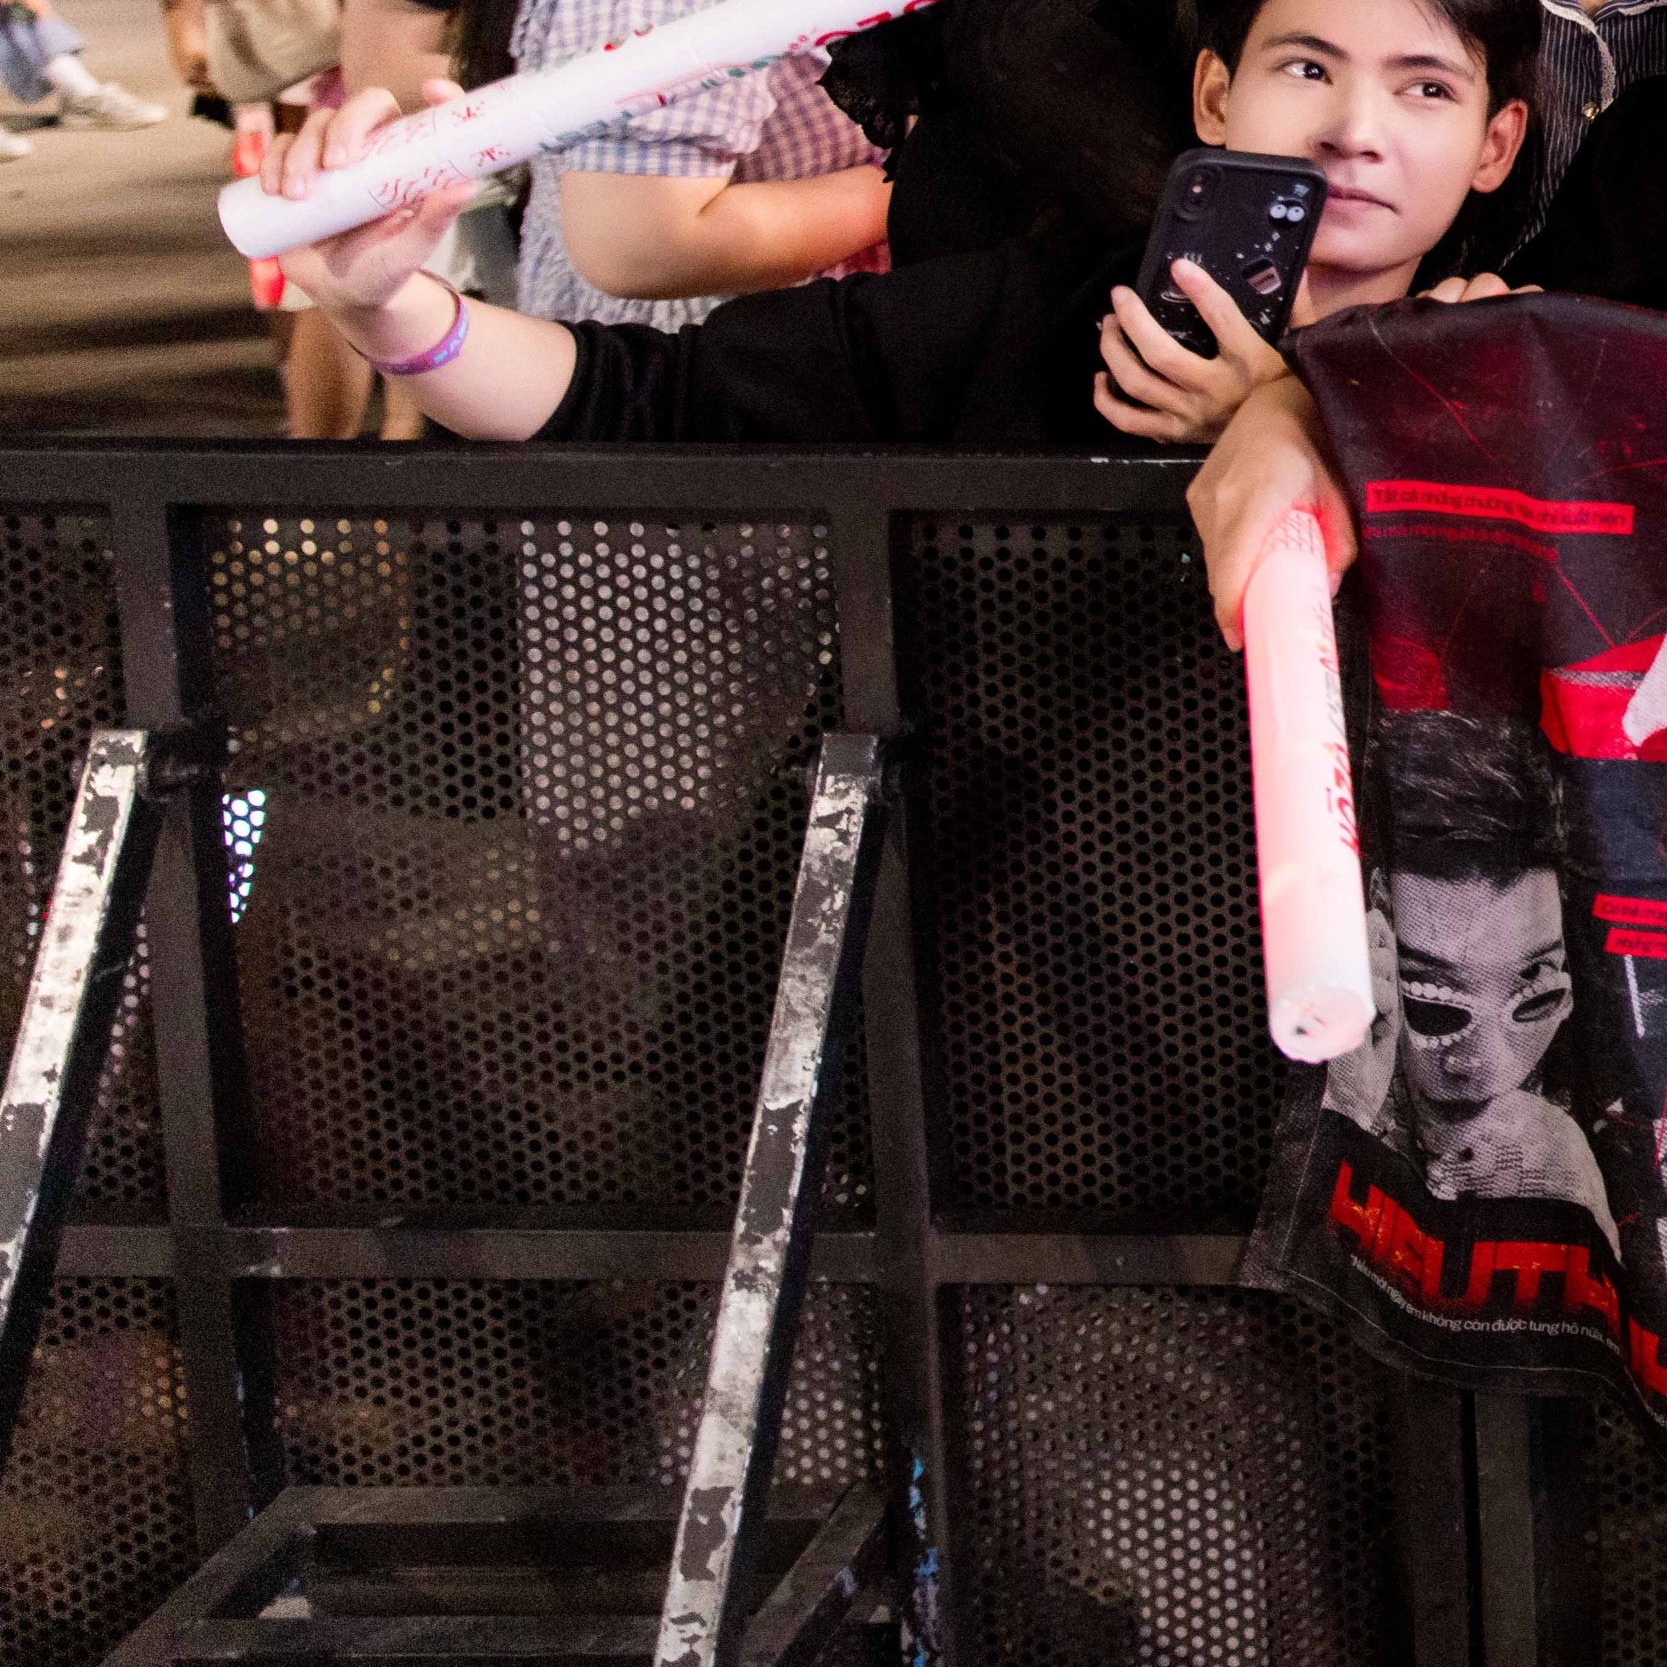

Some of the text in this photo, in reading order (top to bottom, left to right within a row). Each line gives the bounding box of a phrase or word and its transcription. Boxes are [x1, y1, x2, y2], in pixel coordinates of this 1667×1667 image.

[1462, 1318, 1491, 1332] còn
[1491, 1318, 1528, 1334] được
[1528, 1320, 1560, 1336] tung
